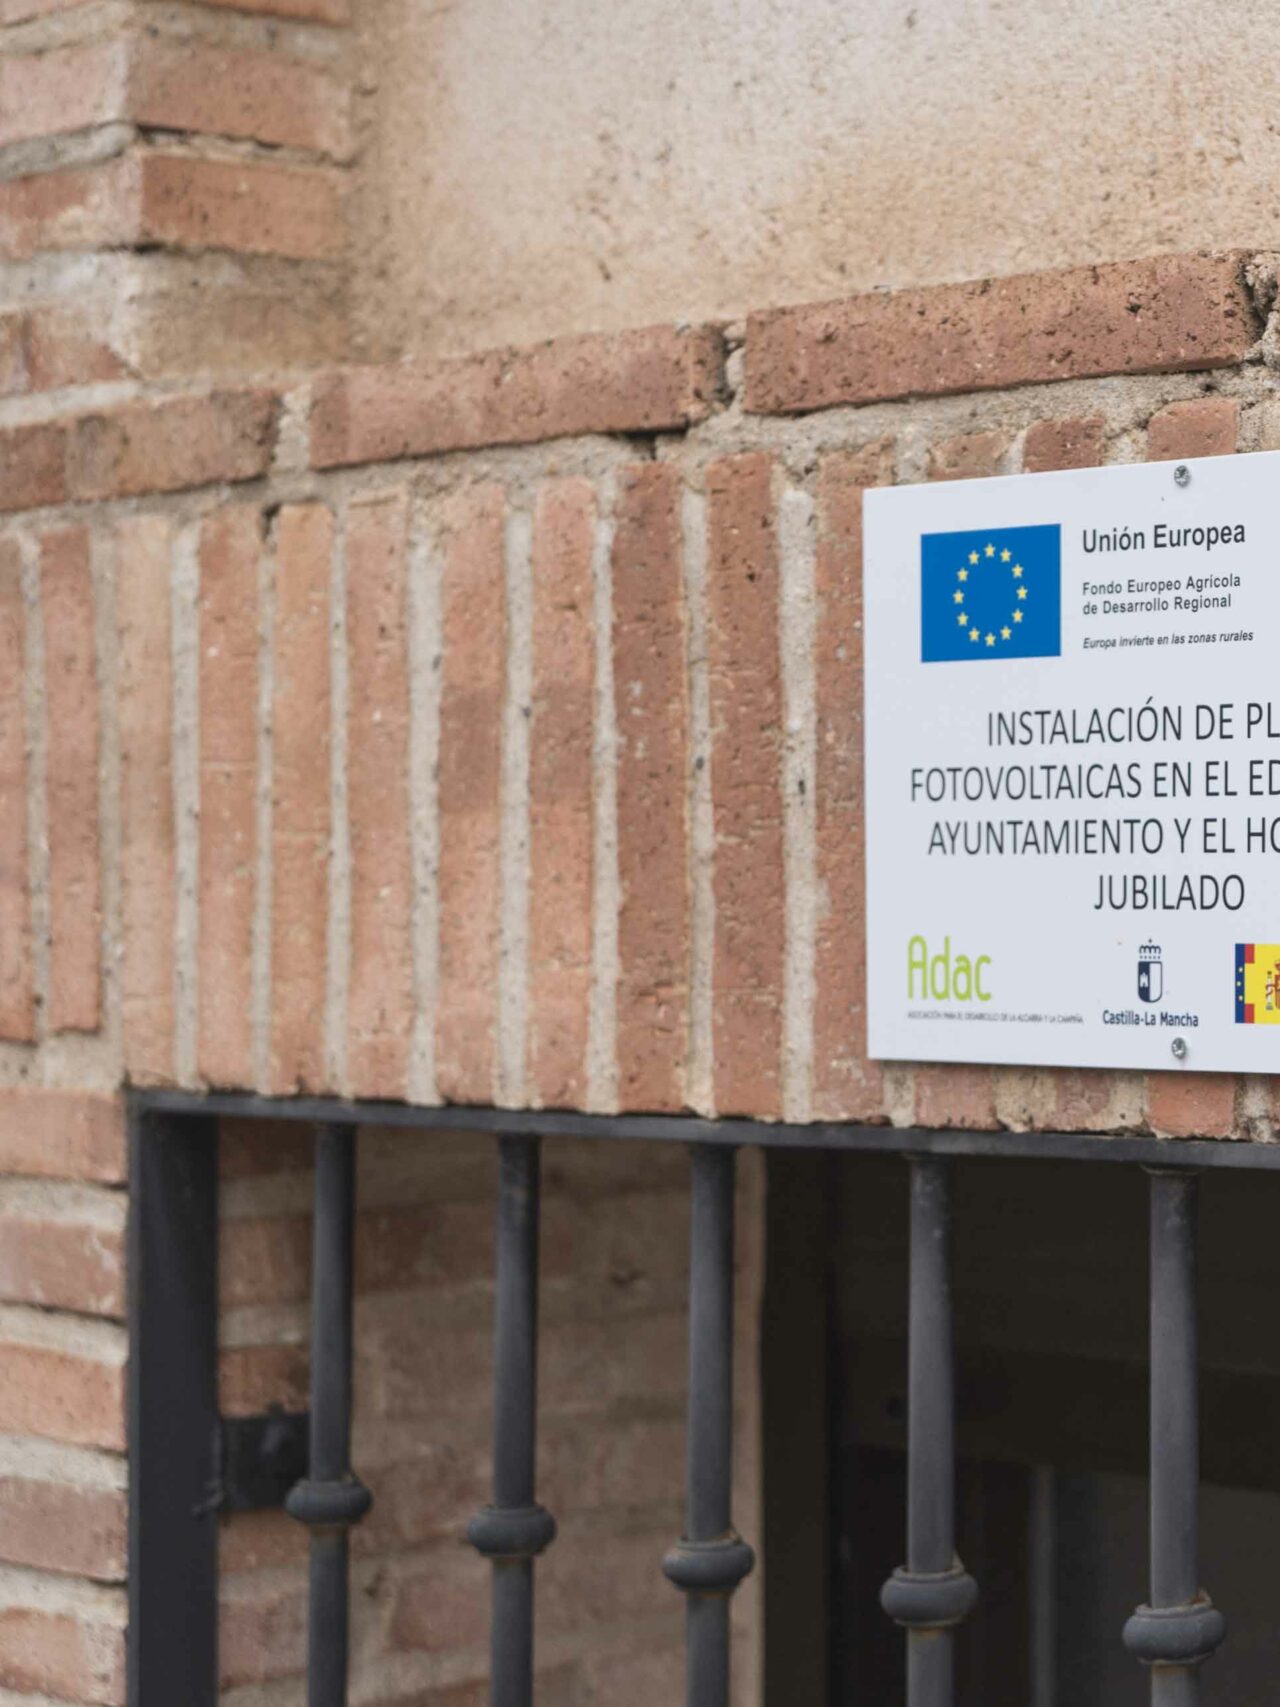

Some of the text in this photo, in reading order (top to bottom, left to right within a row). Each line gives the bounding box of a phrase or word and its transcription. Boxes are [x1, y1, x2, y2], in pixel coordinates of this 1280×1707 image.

[1082, 523, 1246, 553] Unión Europea
[1082, 573, 1241, 596] Fondo Europeo Agrícola
[1082, 594, 1232, 615] de Desarrollo Regional
[1082, 629, 1254, 650] Europa invierte en las zonas rurales
[988, 696, 1182, 747] INSTALACIÓN
[1195, 703, 1235, 741] DE
[910, 762, 1142, 803] FOTOVOLTAICAS
[1153, 761, 1192, 799] EN
[1204, 760, 1239, 798] EL
[927, 818, 1164, 856] AYUNTAMIENTO
[1173, 818, 1192, 855] Y
[1202, 817, 1236, 854] EL
[1093, 874, 1246, 912] JUBILADO
[907, 935, 992, 1003] Adac
[1102, 1009, 1199, 1028] Castilla-La Mancha
